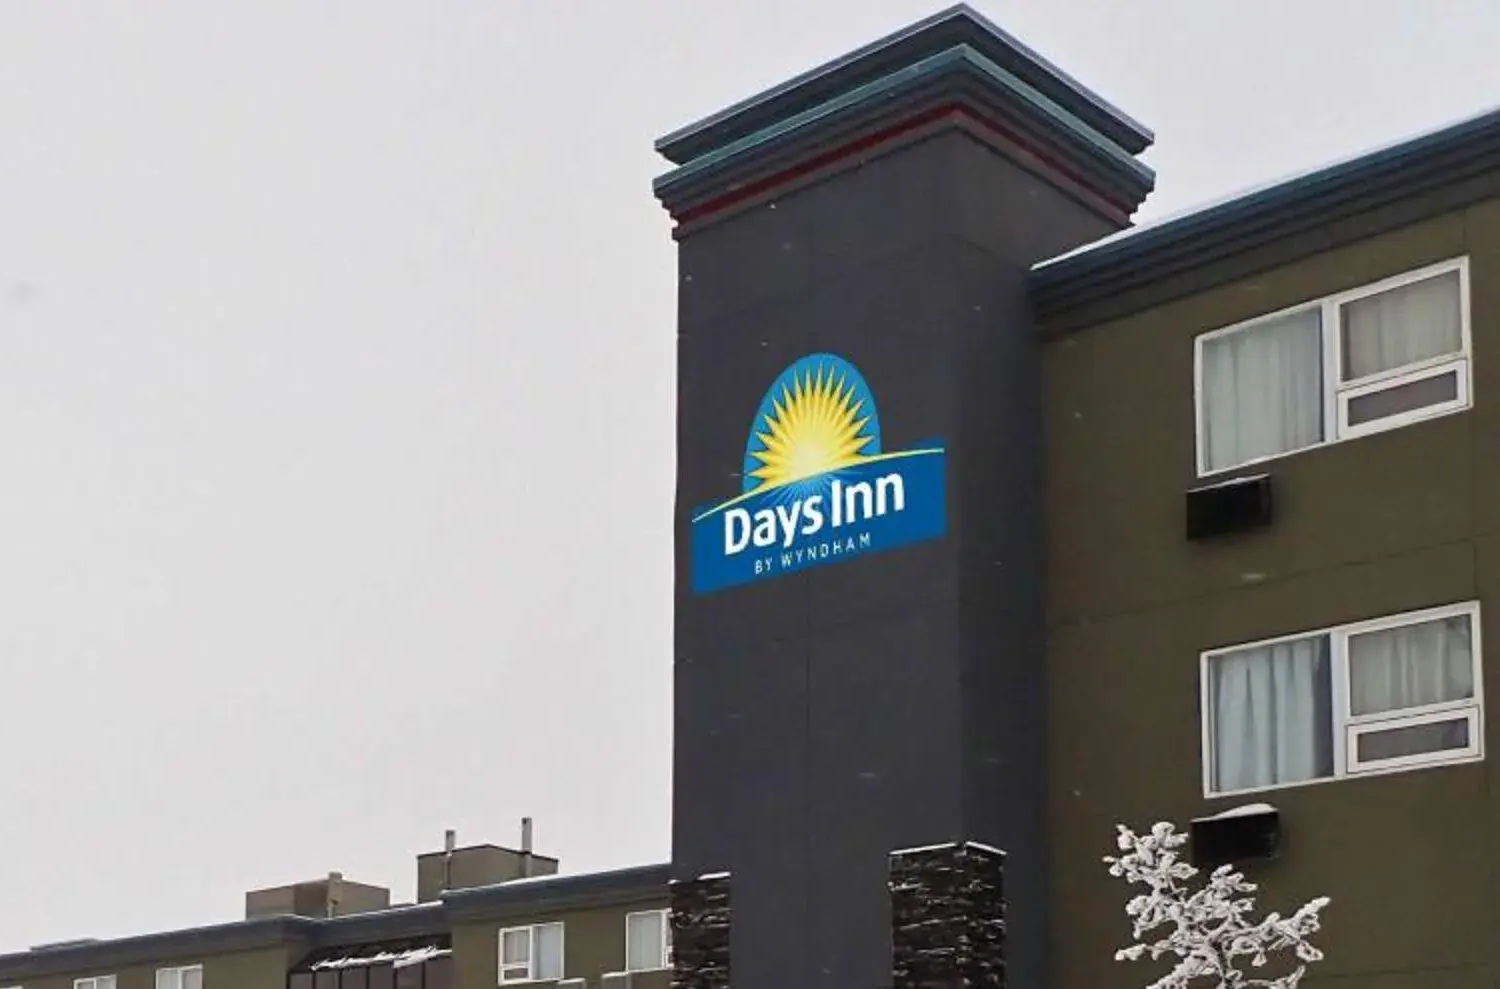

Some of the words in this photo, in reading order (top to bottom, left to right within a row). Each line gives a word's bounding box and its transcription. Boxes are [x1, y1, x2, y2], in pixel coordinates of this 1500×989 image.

[724, 494, 824, 555] Days
[831, 471, 905, 527] Inn
[755, 556, 773, 574] BY
[781, 532, 872, 568] WYNDHAM
